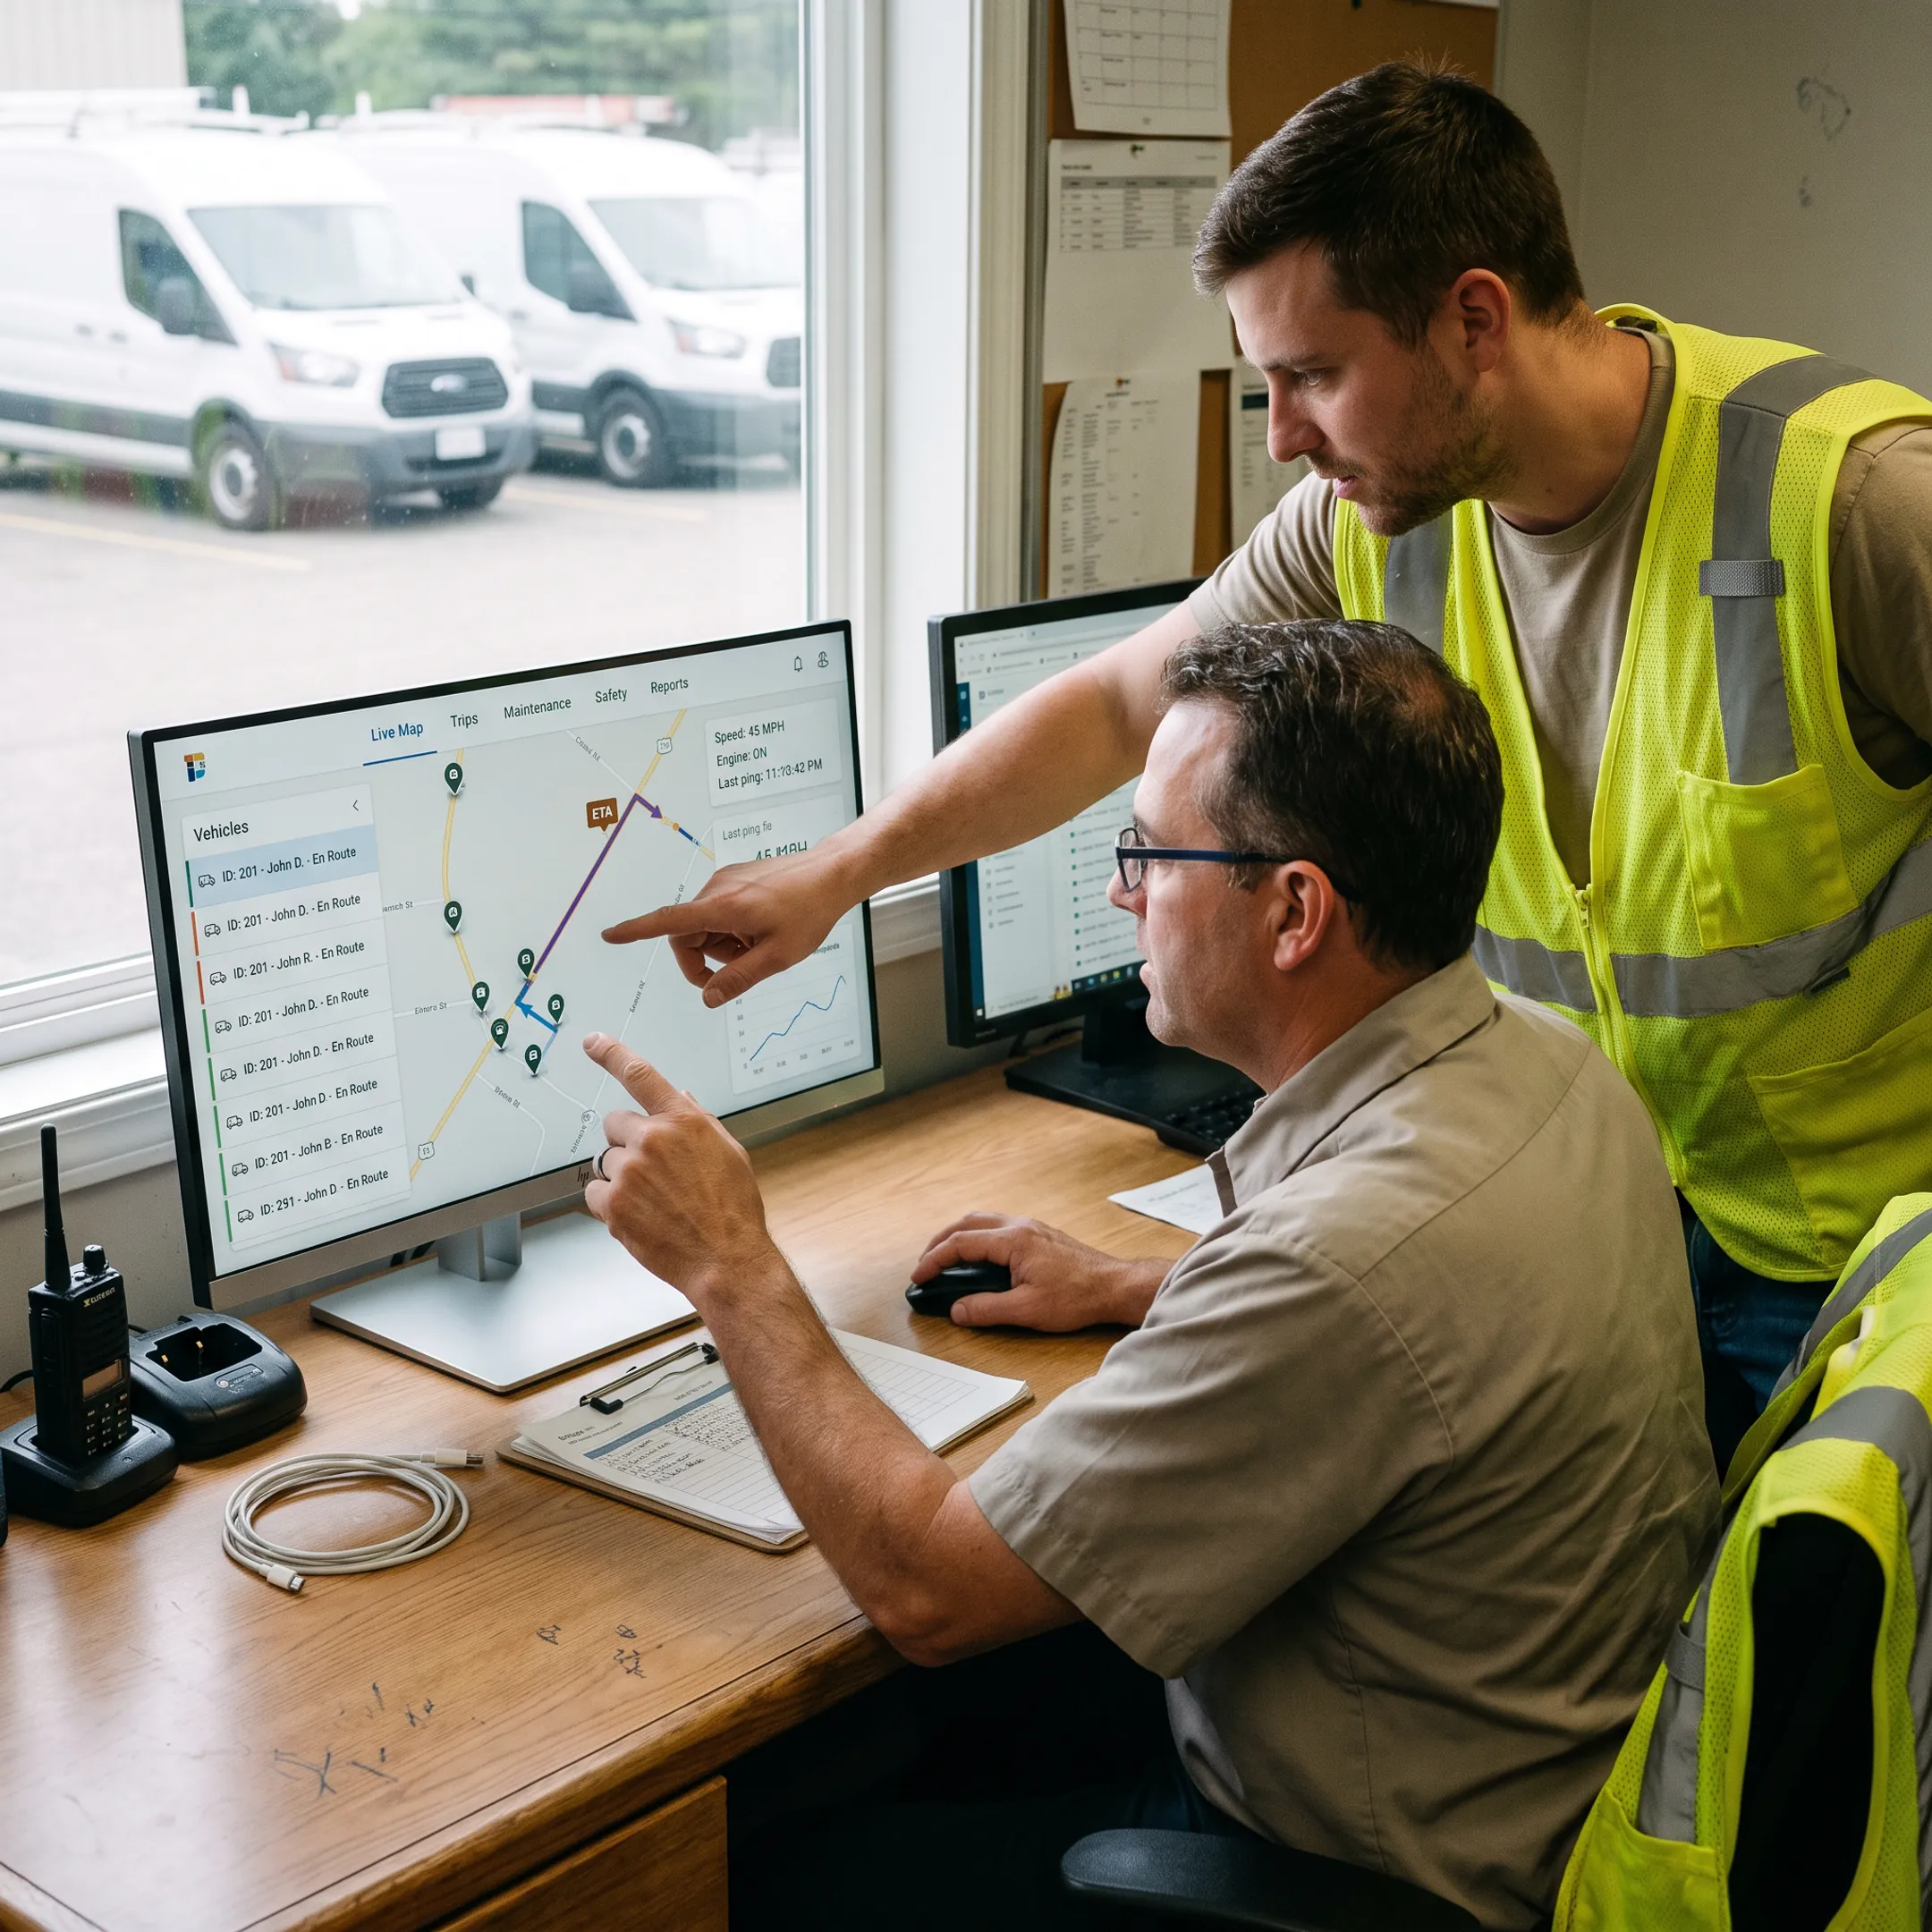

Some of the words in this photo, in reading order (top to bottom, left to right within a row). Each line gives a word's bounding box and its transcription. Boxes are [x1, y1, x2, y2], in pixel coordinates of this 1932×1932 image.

[596, 689, 628, 703] Safety
[651, 679, 689, 695] Reports
[450, 714, 478, 729] Trips
[504, 699, 572, 718] Maintenance
[371, 727, 395, 741] Live
[398, 723, 423, 737] Map
[715, 727, 746, 746] Speed:
[749, 724, 760, 737] 45
[762, 720, 784, 734] MPH
[717, 752, 750, 767] Engine:
[753, 747, 767, 759] ON
[718, 776, 740, 789] Last
[741, 772, 763, 787] ping:
[808, 758, 822, 771] PM
[592, 805, 613, 819] ETA
[193, 821, 250, 842] Vehicles
[723, 828, 741, 840] Last
[742, 825, 760, 839] ping
[223, 870, 236, 883] ID:
[239, 866, 257, 879] 201
[267, 860, 292, 874] John
[294, 856, 304, 869] D.
[313, 853, 325, 865] En
[327, 848, 356, 861] Route
[227, 919, 242, 932] ID:
[243, 914, 261, 928] 201
[271, 908, 296, 922] John
[299, 904, 309, 917] D.
[318, 901, 329, 913] En
[333, 895, 360, 910] Route
[233, 967, 248, 979] ID:
[250, 962, 267, 975] 201
[277, 955, 301, 970] John
[303, 952, 313, 963] R.
[321, 947, 334, 960] En
[336, 942, 364, 956] Route
[238, 1015, 251, 1027] ID:
[254, 1010, 272, 1024] 201
[282, 1003, 306, 1017] John
[308, 999, 318, 1011] D.
[326, 994, 338, 1006] En
[341, 988, 369, 1003] Route
[243, 1063, 258, 1075] ID:
[259, 1057, 277, 1071] 201
[287, 1050, 311, 1064] John
[332, 1040, 343, 1053] En
[346, 1034, 374, 1049] Route
[250, 1111, 263, 1123] ID:
[265, 1104, 283, 1118] 201
[292, 1097, 317, 1111] John
[336, 1087, 348, 1099] En
[350, 1080, 377, 1096] Route
[255, 1157, 268, 1169] ID:
[271, 1150, 288, 1165] 201
[299, 1143, 322, 1157] John
[342, 1133, 354, 1146] En
[356, 1126, 383, 1140] Route
[260, 1204, 274, 1216] ID:
[276, 1197, 293, 1211] 291
[304, 1189, 327, 1203] John
[347, 1178, 360, 1191] En
[361, 1171, 388, 1185] Route
